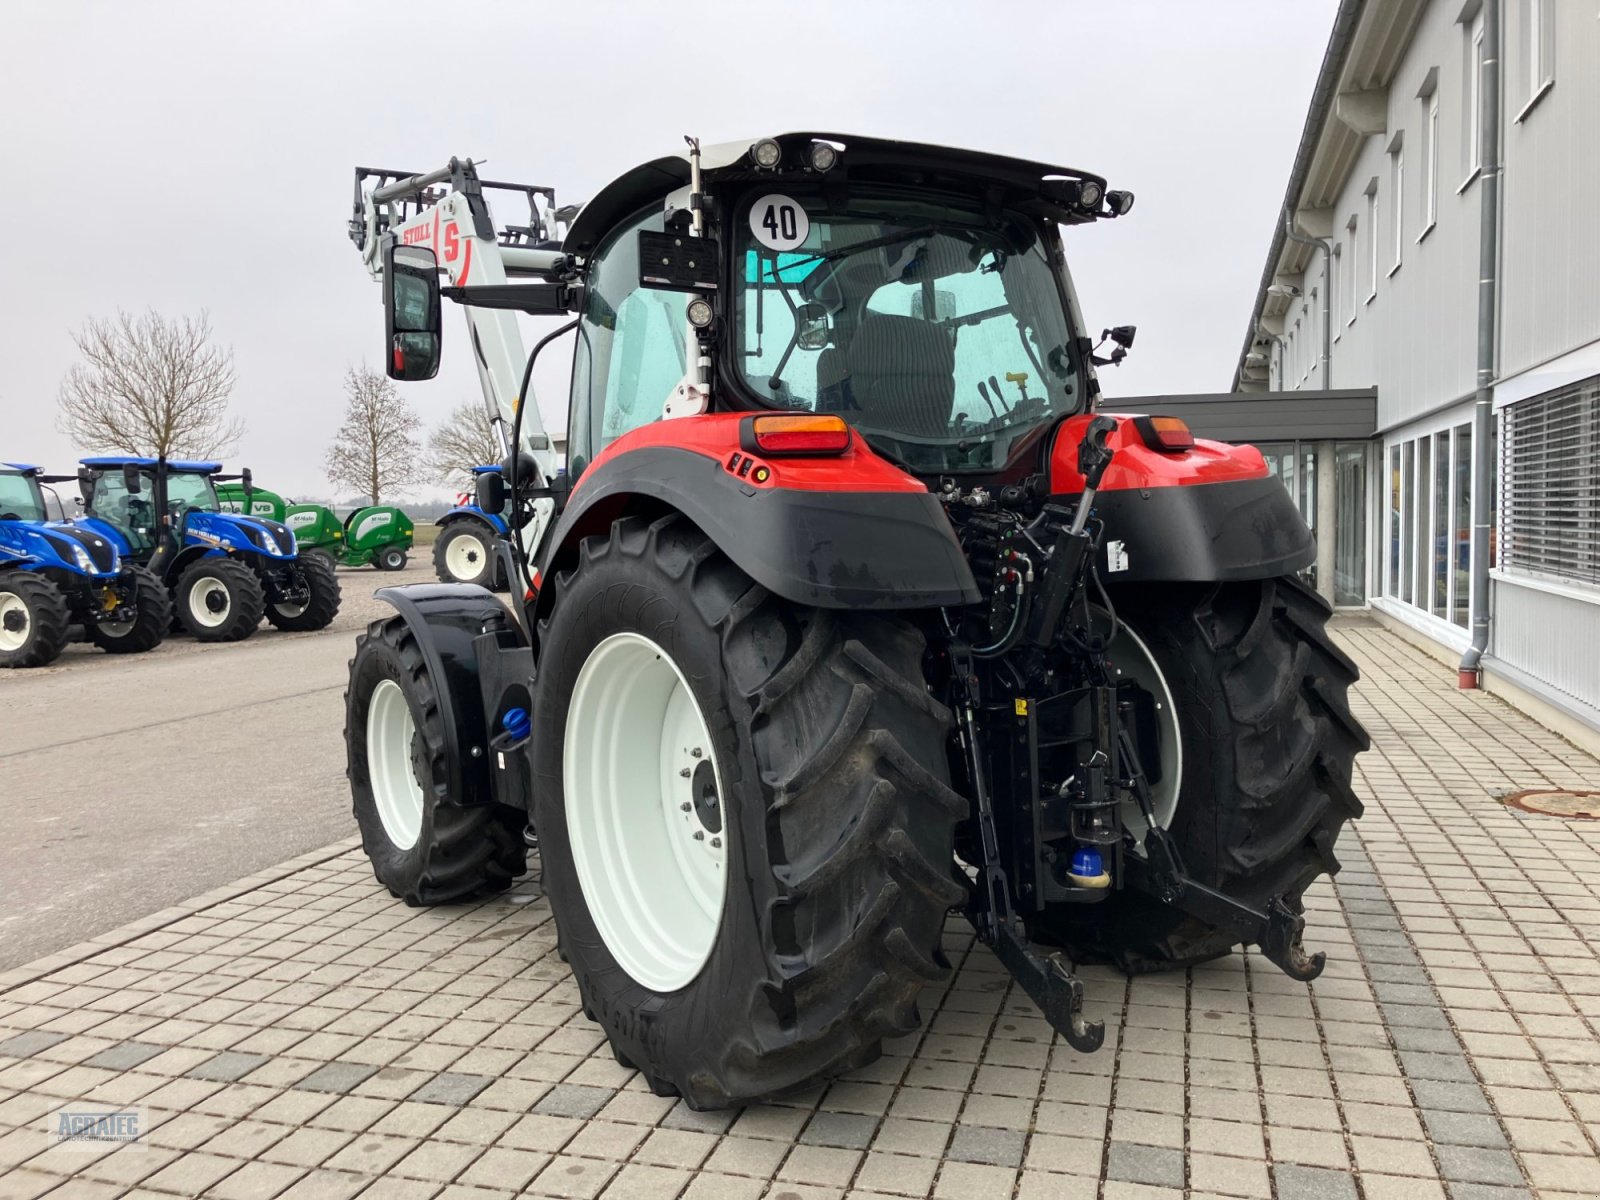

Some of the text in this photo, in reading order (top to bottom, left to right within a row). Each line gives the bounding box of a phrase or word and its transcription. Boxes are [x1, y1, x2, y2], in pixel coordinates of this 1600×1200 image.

[403, 222, 431, 246] STOLL
[762, 204, 797, 240] 40
[444, 221, 459, 262] S
